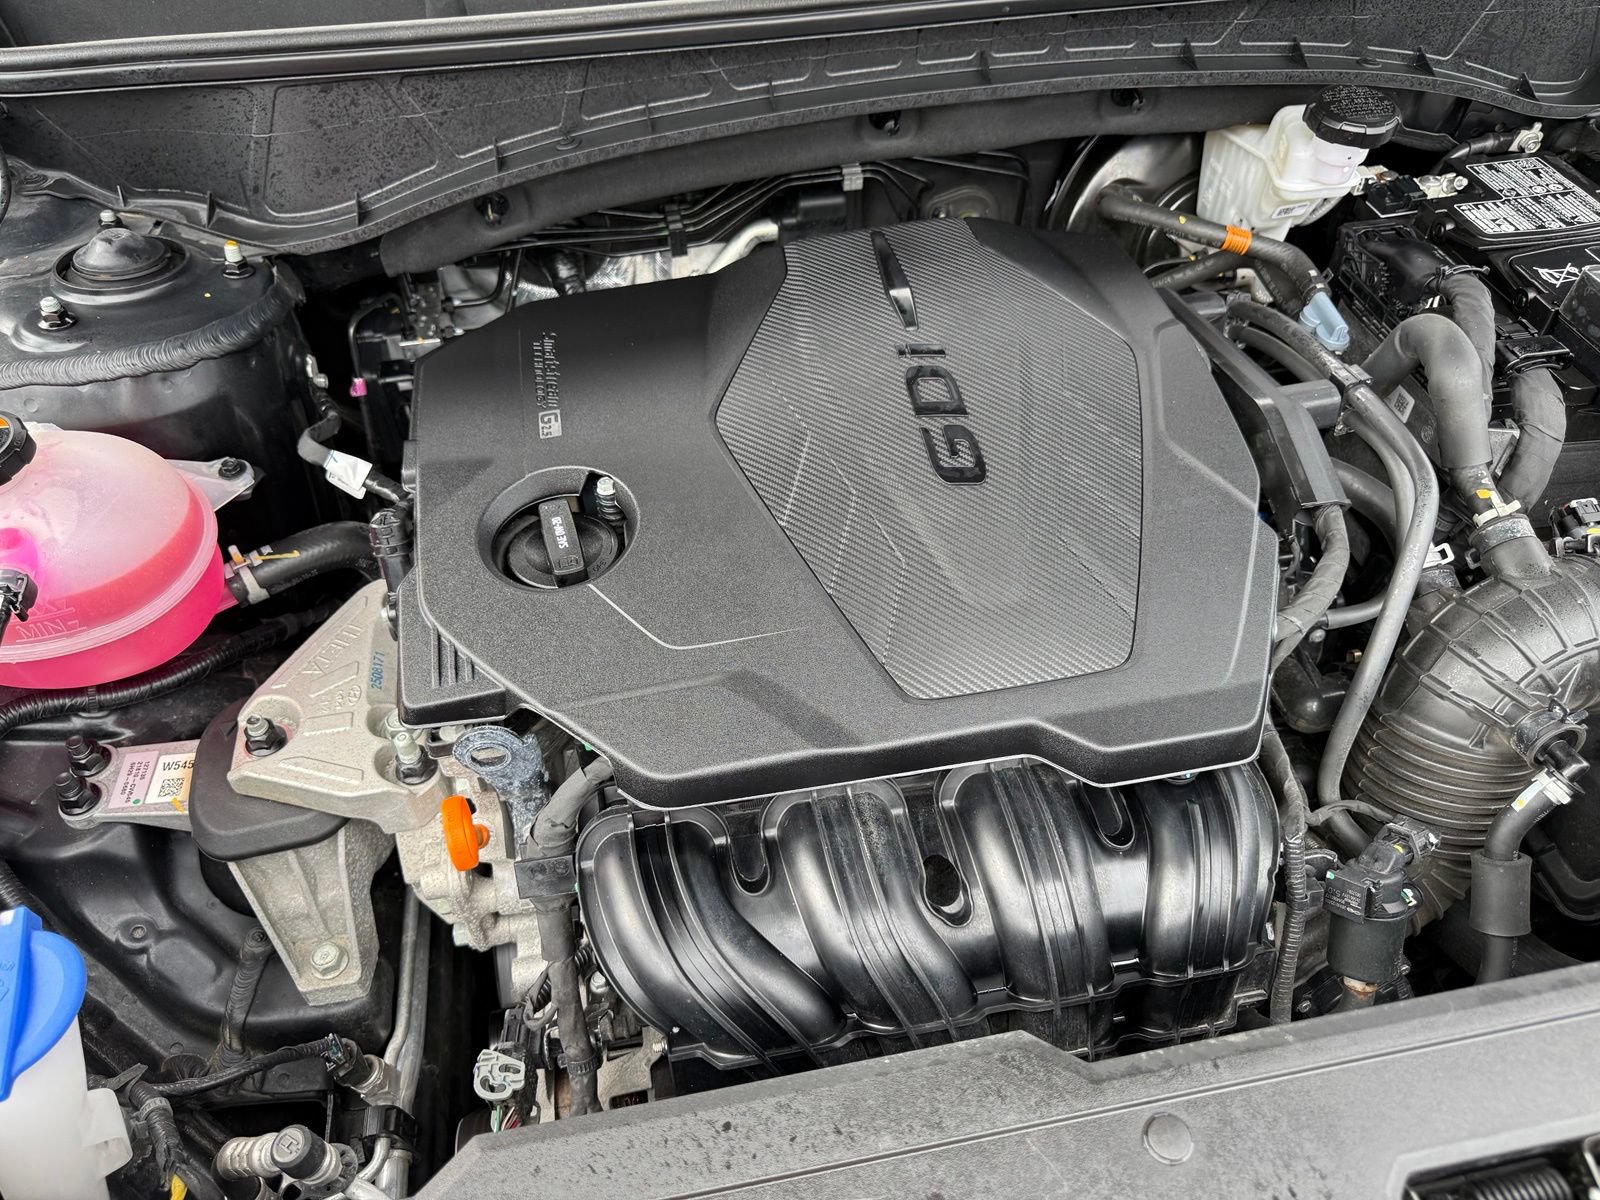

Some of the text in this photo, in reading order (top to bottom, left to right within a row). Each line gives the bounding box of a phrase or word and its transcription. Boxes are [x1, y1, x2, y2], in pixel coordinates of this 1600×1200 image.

[897, 343, 987, 485] GDi
[556, 536, 569, 549] SAE
[370, 650, 385, 690] 2508171
